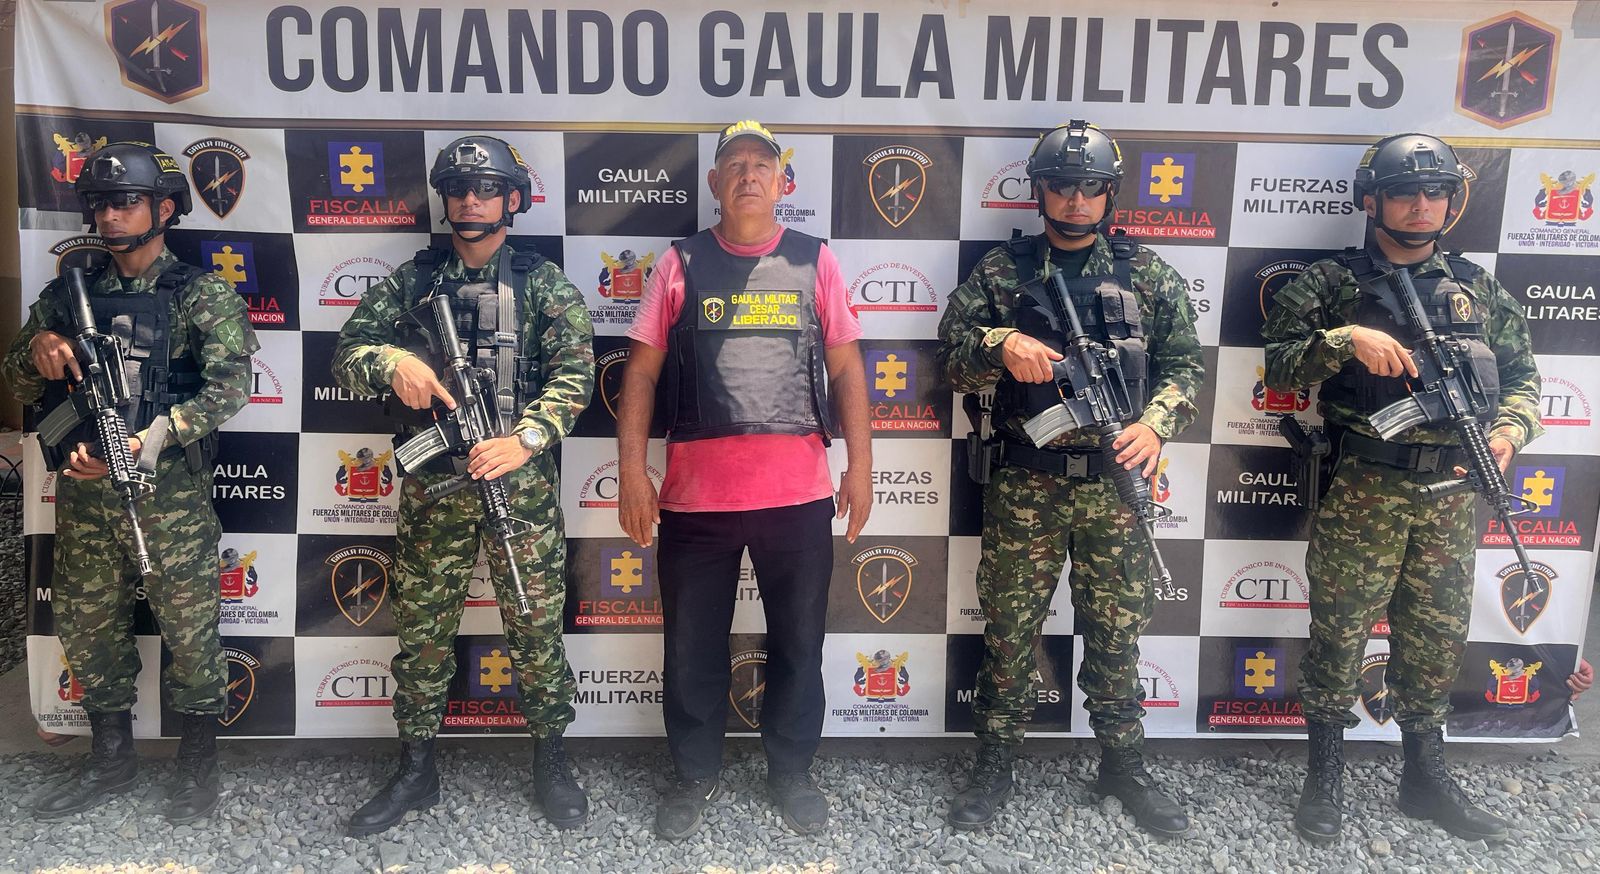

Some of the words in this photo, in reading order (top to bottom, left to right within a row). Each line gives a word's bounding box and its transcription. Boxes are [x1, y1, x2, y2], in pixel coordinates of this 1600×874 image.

[266, 5, 670, 97] COMANDO
[699, 9, 956, 99] GAULA
[982, 15, 1408, 110] MILITARES
[187, 140, 213, 155] GAULA
[215, 140, 247, 159] MILITAR
[868, 148, 895, 164] GAULA
[897, 147, 928, 165] MILITAR
[598, 168, 670, 183] GAULA
[982, 175, 998, 199] CUERPO
[1250, 177, 1348, 194] FUERZAS
[578, 189, 688, 204] MILITARES
[309, 199, 410, 213] FISCALIA
[775, 208, 783, 216] DE
[784, 208, 816, 216] COLOMBIA
[1243, 198, 1353, 216] MILITARES
[308, 216, 352, 224] GENERAL
[353, 216, 365, 224] DE
[380, 216, 415, 224] NACION
[1114, 209, 1212, 226] FISCALIA
[1153, 227, 1166, 236] DE
[1167, 228, 1178, 236] LA
[1180, 228, 1215, 237] NACION
[1507, 232, 1535, 240] FUERZAS
[1535, 233, 1568, 241] MILITARES
[1578, 234, 1600, 242] COLOM
[54, 238, 84, 253] GAULA
[1539, 240, 1571, 248] INTEGRIDAD
[1260, 263, 1287, 277] GAULA
[319, 272, 335, 297] CUERPO
[860, 280, 918, 303] CTI
[1526, 284, 1596, 300] GAULA
[731, 294, 760, 304] GAULA
[764, 294, 798, 305] MILITAR
[605, 310, 637, 318] MILITARES
[749, 304, 780, 314] CESAR
[1524, 305, 1600, 321] LITARE
[251, 313, 284, 322] NACION
[732, 315, 797, 325] LIBERADO
[600, 351, 625, 365] GAULA
[870, 404, 936, 419] CALIA
[1541, 395, 1574, 417] TI
[881, 421, 893, 429] DE
[894, 421, 906, 429] LA
[906, 421, 939, 430] NACION
[1227, 421, 1255, 430] FUERZAS
[213, 464, 268, 479] AULA
[871, 471, 932, 485] ERZAS
[580, 474, 596, 499] CUERPO
[594, 459, 619, 476] TÉCNIC
[1238, 471, 1297, 487] GAUL
[212, 485, 286, 500] ITARES
[874, 491, 939, 505] TARES
[1217, 490, 1299, 506] MILITAR
[312, 508, 340, 516] FUERZAS
[340, 509, 372, 517] MILITARES
[381, 510, 399, 518] COLO
[344, 516, 375, 524] INTEGRIDAD
[1488, 519, 1578, 534] FICALIA
[1483, 535, 1512, 543] GENER
[1548, 536, 1580, 544] NACION
[330, 549, 357, 564] GAULA
[358, 549, 390, 565] MILITAR
[856, 549, 882, 564] GAULA
[883, 548, 913, 565] MILITAR
[1220, 576, 1236, 599] CUERPO
[1235, 578, 1290, 601] CTI
[237, 610, 246, 618] DE
[246, 610, 279, 618] COLOMBIA
[960, 608, 982, 616] FUERZA
[576, 616, 617, 625] GENERAL
[618, 616, 630, 624] DE
[631, 616, 642, 624] LA
[643, 616, 664, 624] NACI
[315, 674, 332, 698] CUERPO
[331, 675, 390, 698] CTI
[573, 691, 664, 704] MILITARE
[448, 701, 521, 714] FISCAL
[1213, 701, 1303, 714] FISCALIA
[444, 716, 486, 725] GENERAL
[487, 717, 498, 725] DE
[500, 717, 512, 725] LA
[1209, 716, 1248, 724] GENERAL
[1249, 716, 1260, 724] DE
[1261, 716, 1273, 724] LA
[1274, 716, 1306, 724] NACION
